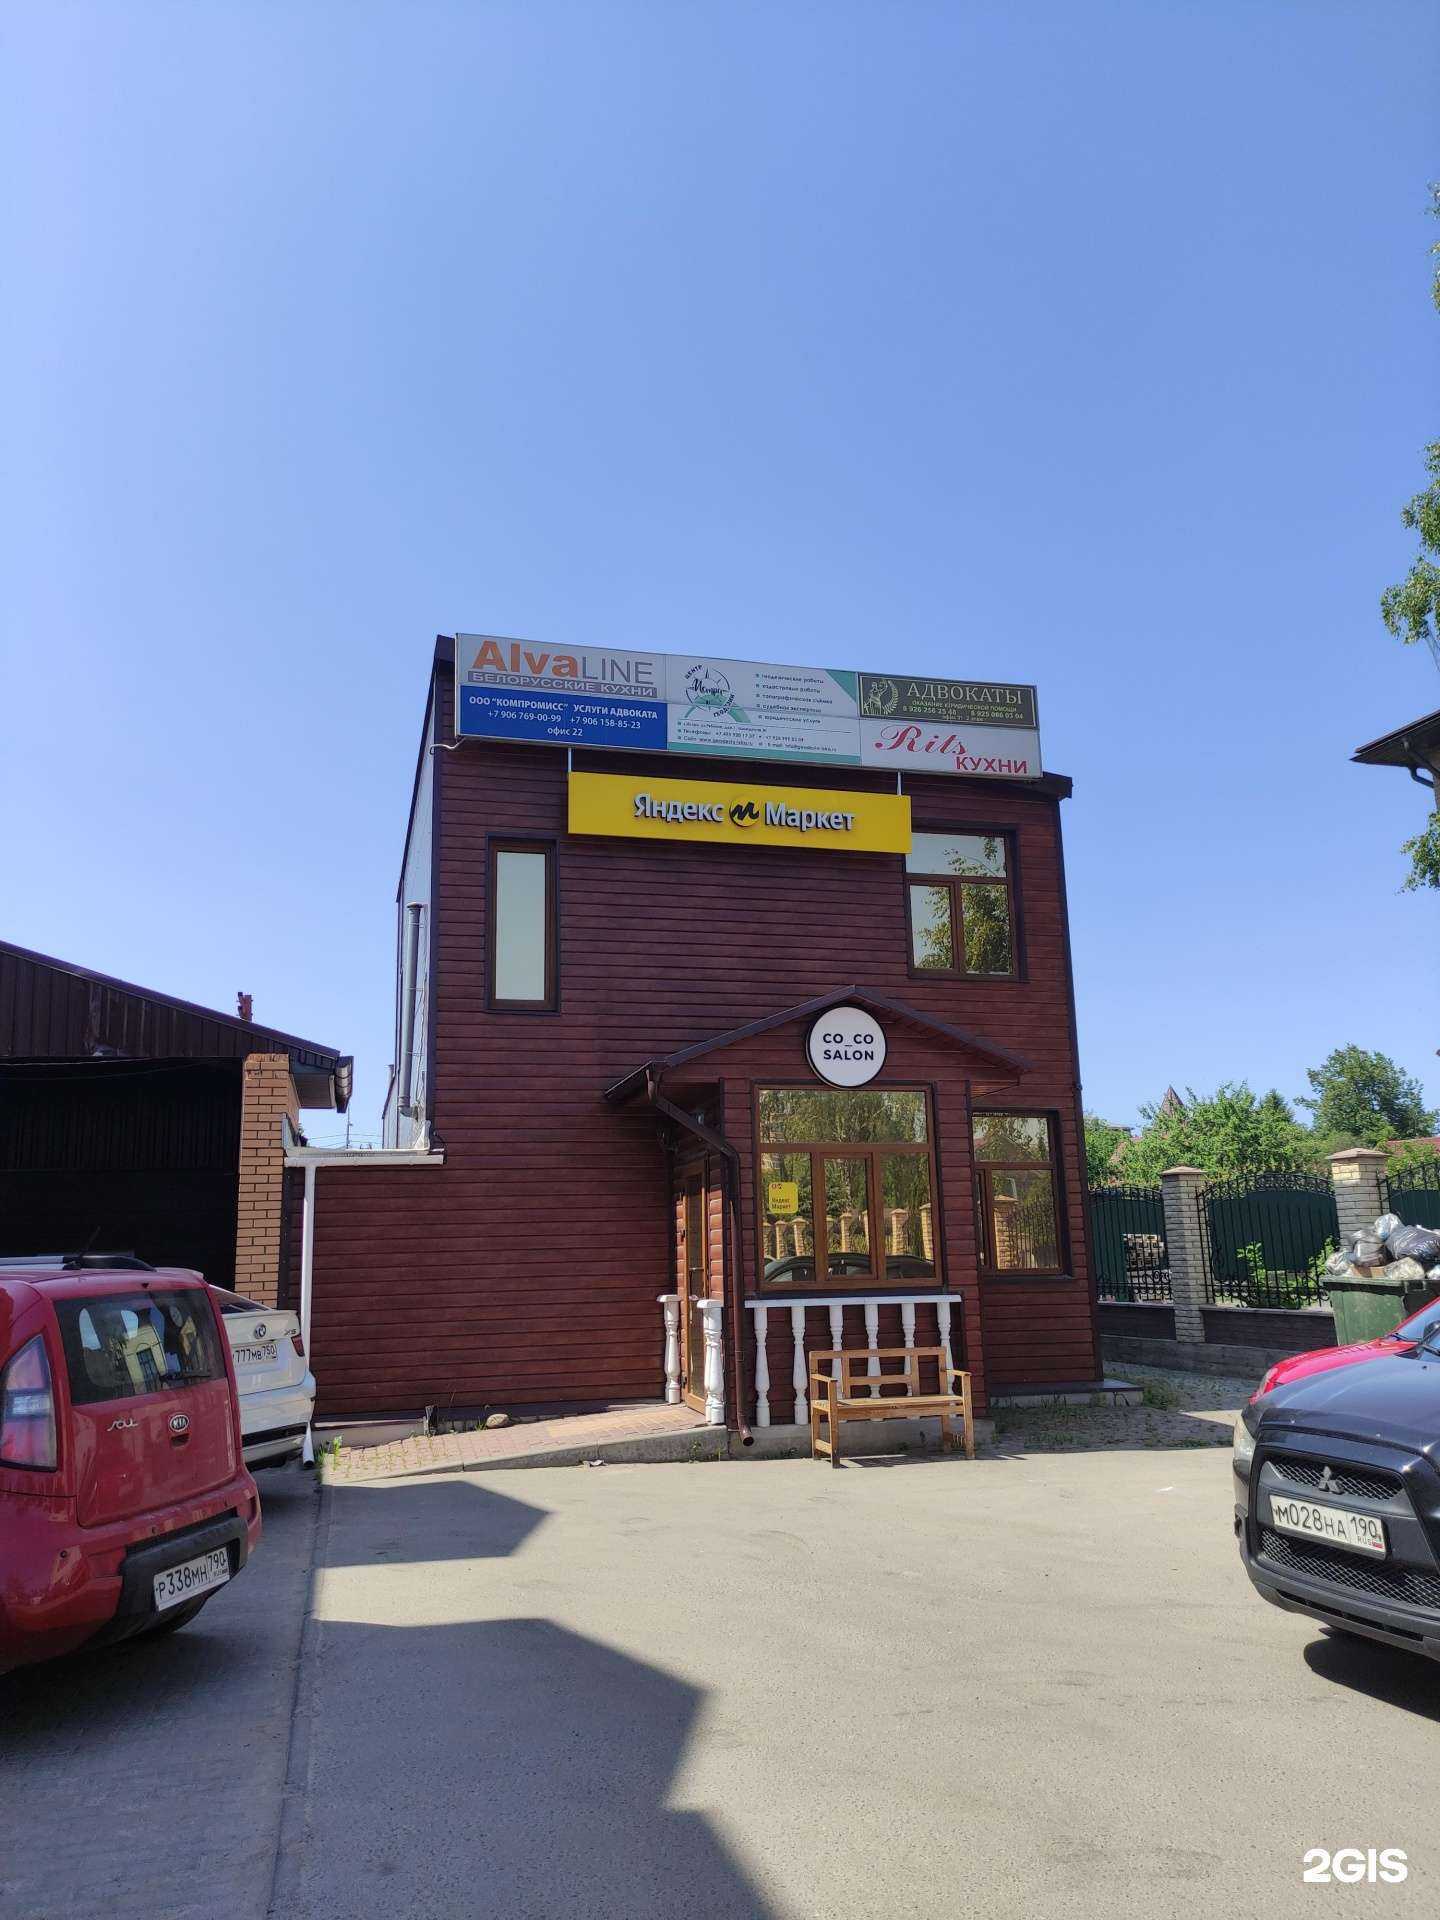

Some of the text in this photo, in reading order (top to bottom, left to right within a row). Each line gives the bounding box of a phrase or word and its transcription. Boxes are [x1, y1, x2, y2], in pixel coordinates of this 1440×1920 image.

[472, 673, 654, 696] БЕЛОРУССКИЕ КУХНИ
[907, 681, 1022, 704] АДВОКАТЫ
[469, 696, 490, 705] ООО
[574, 704, 608, 715] УСЛУГИ
[610, 708, 658, 719] АДВОКАТА
[488, 710, 498, 718] +7
[500, 711, 517, 719] 906
[519, 713, 562, 723] 769-00-99
[582, 717, 598, 725] 906
[600, 718, 641, 729] 158-85-23
[547, 727, 583, 736] офис 22
[956, 756, 1028, 774] КУХНИ
[634, 793, 724, 822] Яндекс
[765, 801, 855, 831] Маркет
[823, 1049, 874, 1061] SALON
